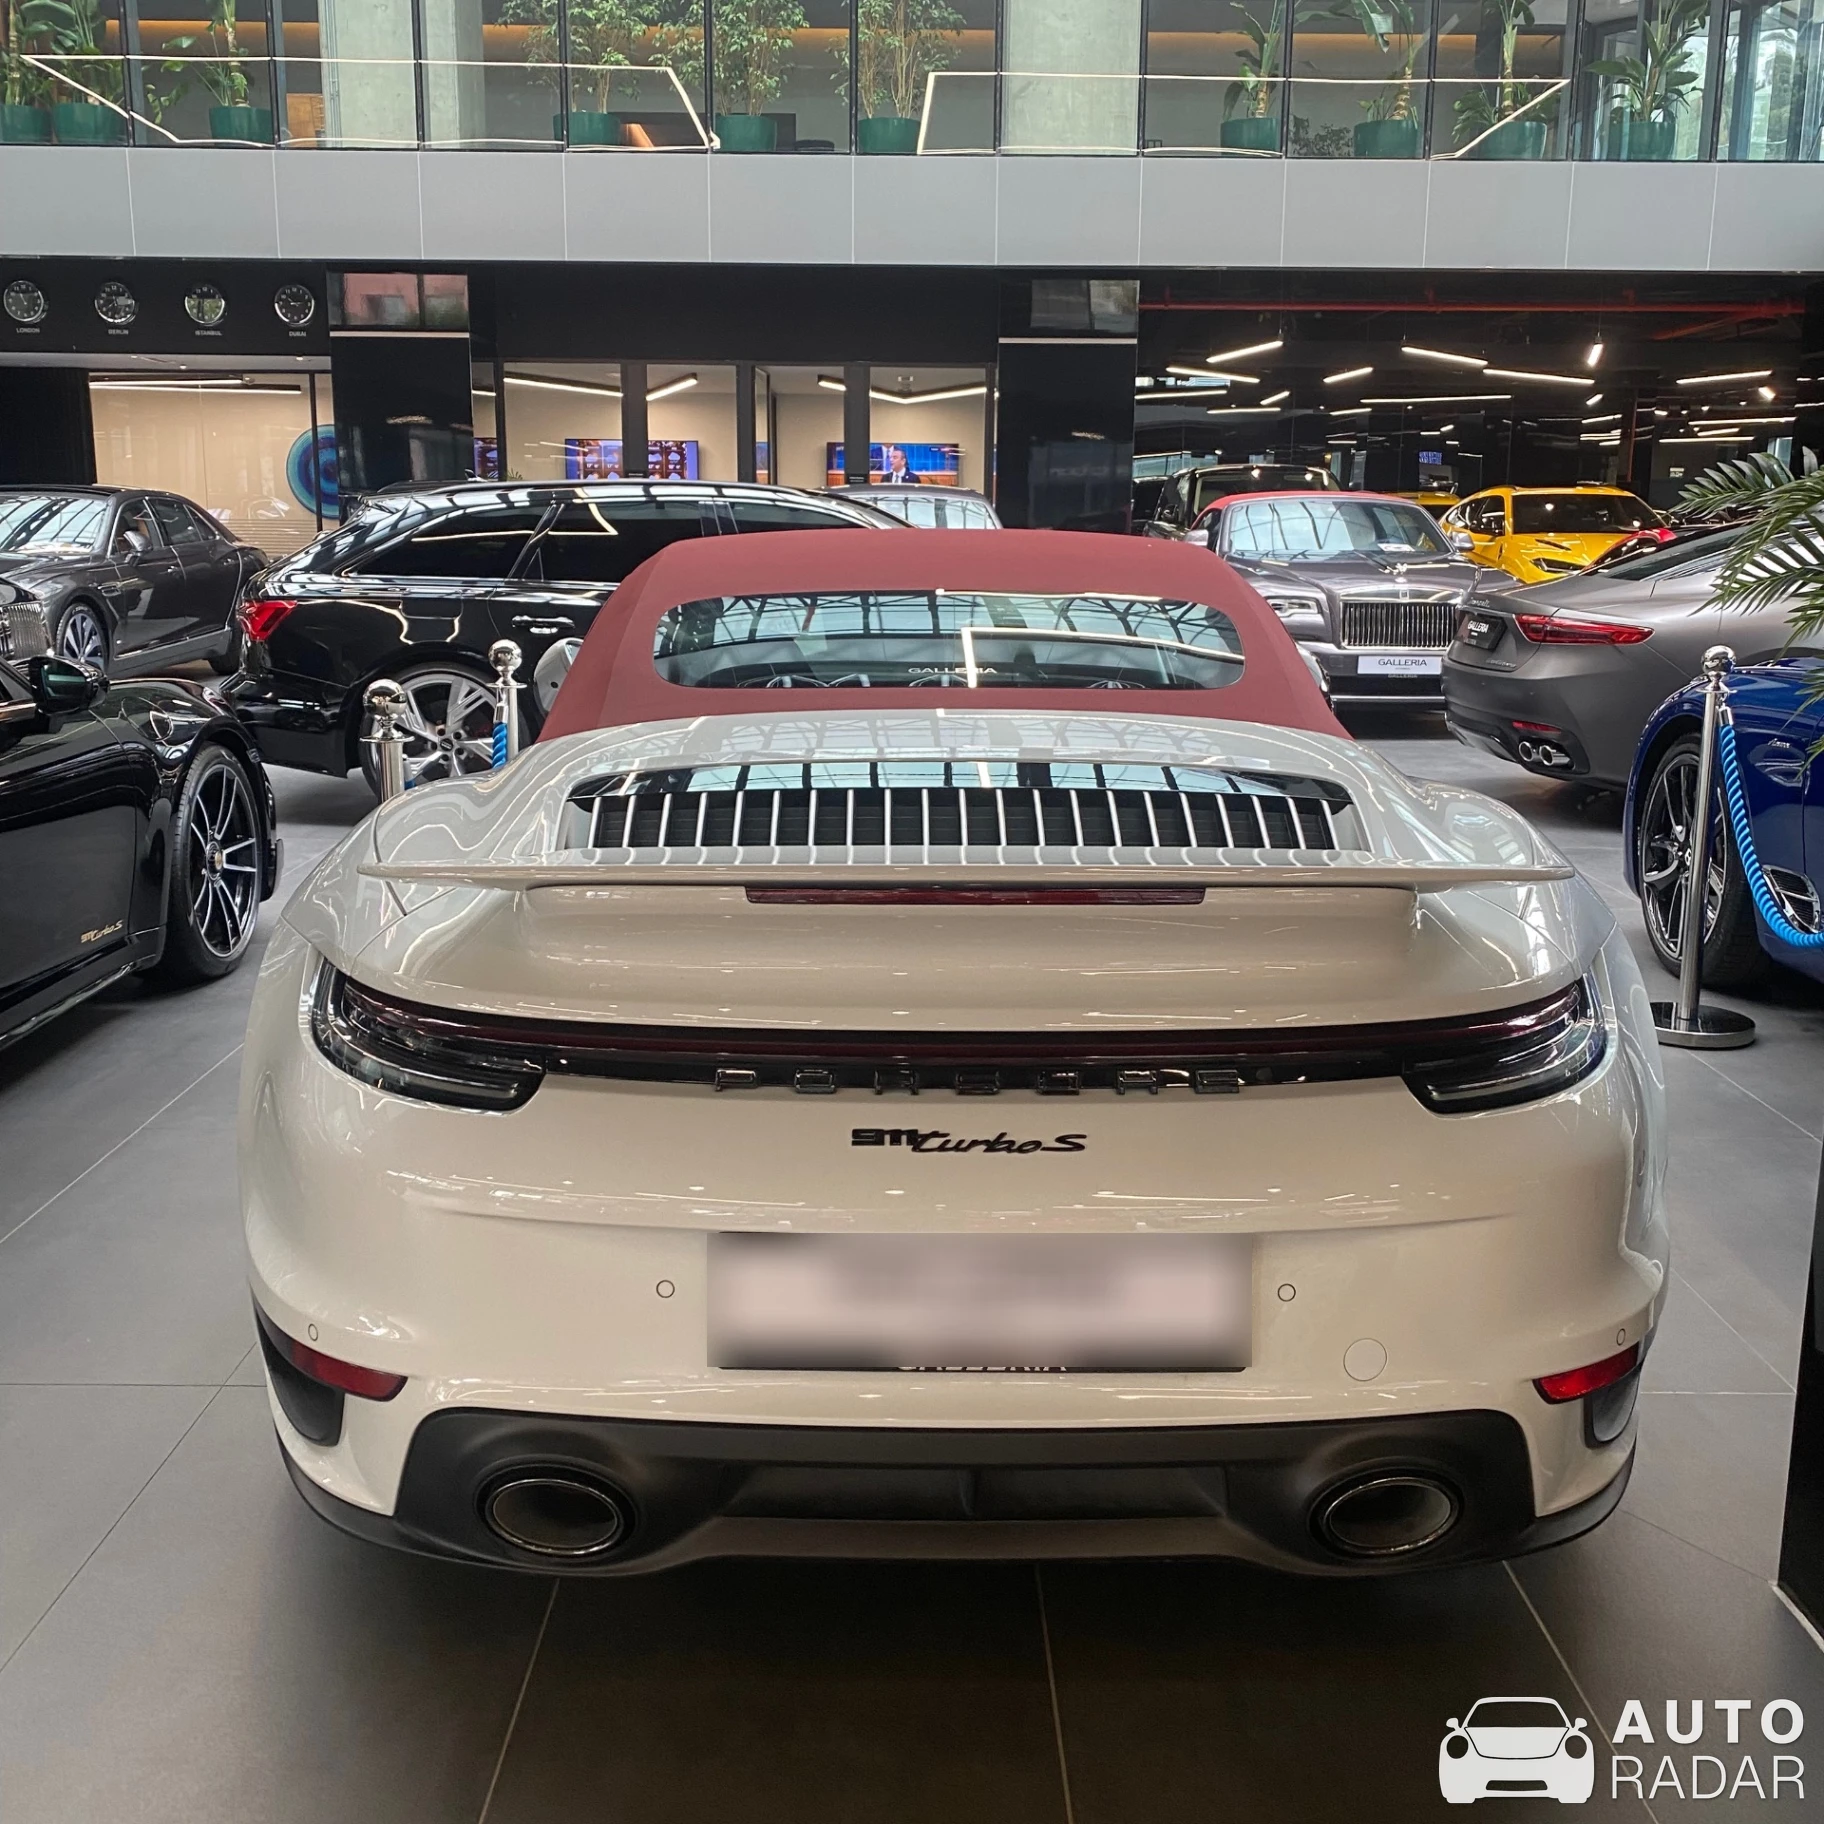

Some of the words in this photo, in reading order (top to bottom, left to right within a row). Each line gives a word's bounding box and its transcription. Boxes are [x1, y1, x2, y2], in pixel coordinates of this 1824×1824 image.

[851, 1128, 919, 1146] 911
[911, 1130, 1043, 1153] turbo
[1040, 1134, 1087, 1152] S
